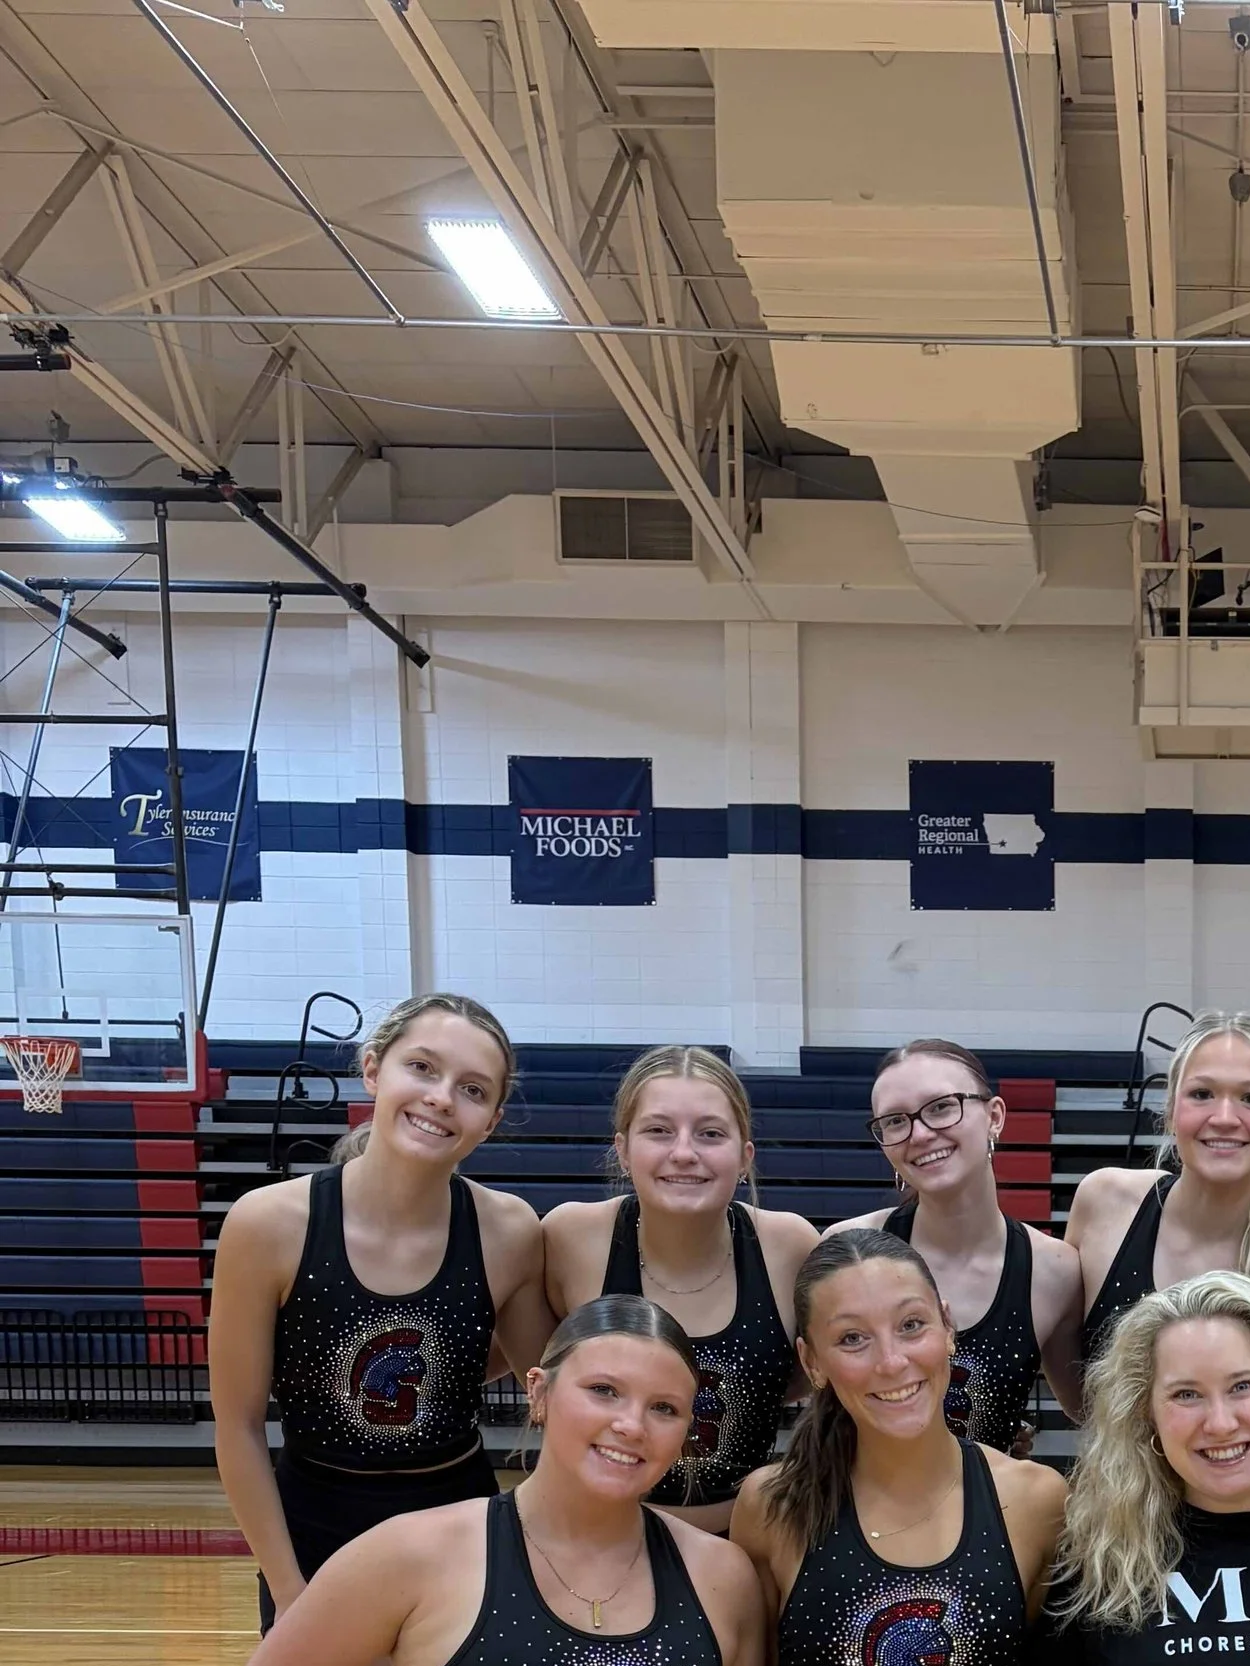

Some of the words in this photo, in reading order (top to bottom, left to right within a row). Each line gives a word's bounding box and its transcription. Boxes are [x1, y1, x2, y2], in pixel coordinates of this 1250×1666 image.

[120, 789, 173, 836] Tyler
[181, 808, 236, 822] nsuranc
[918, 814, 971, 827] Greater
[520, 816, 641, 837] MICHAEL
[918, 829, 979, 844] Regional
[535, 837, 621, 857] FOODS
[918, 846, 963, 854] HEALTH
